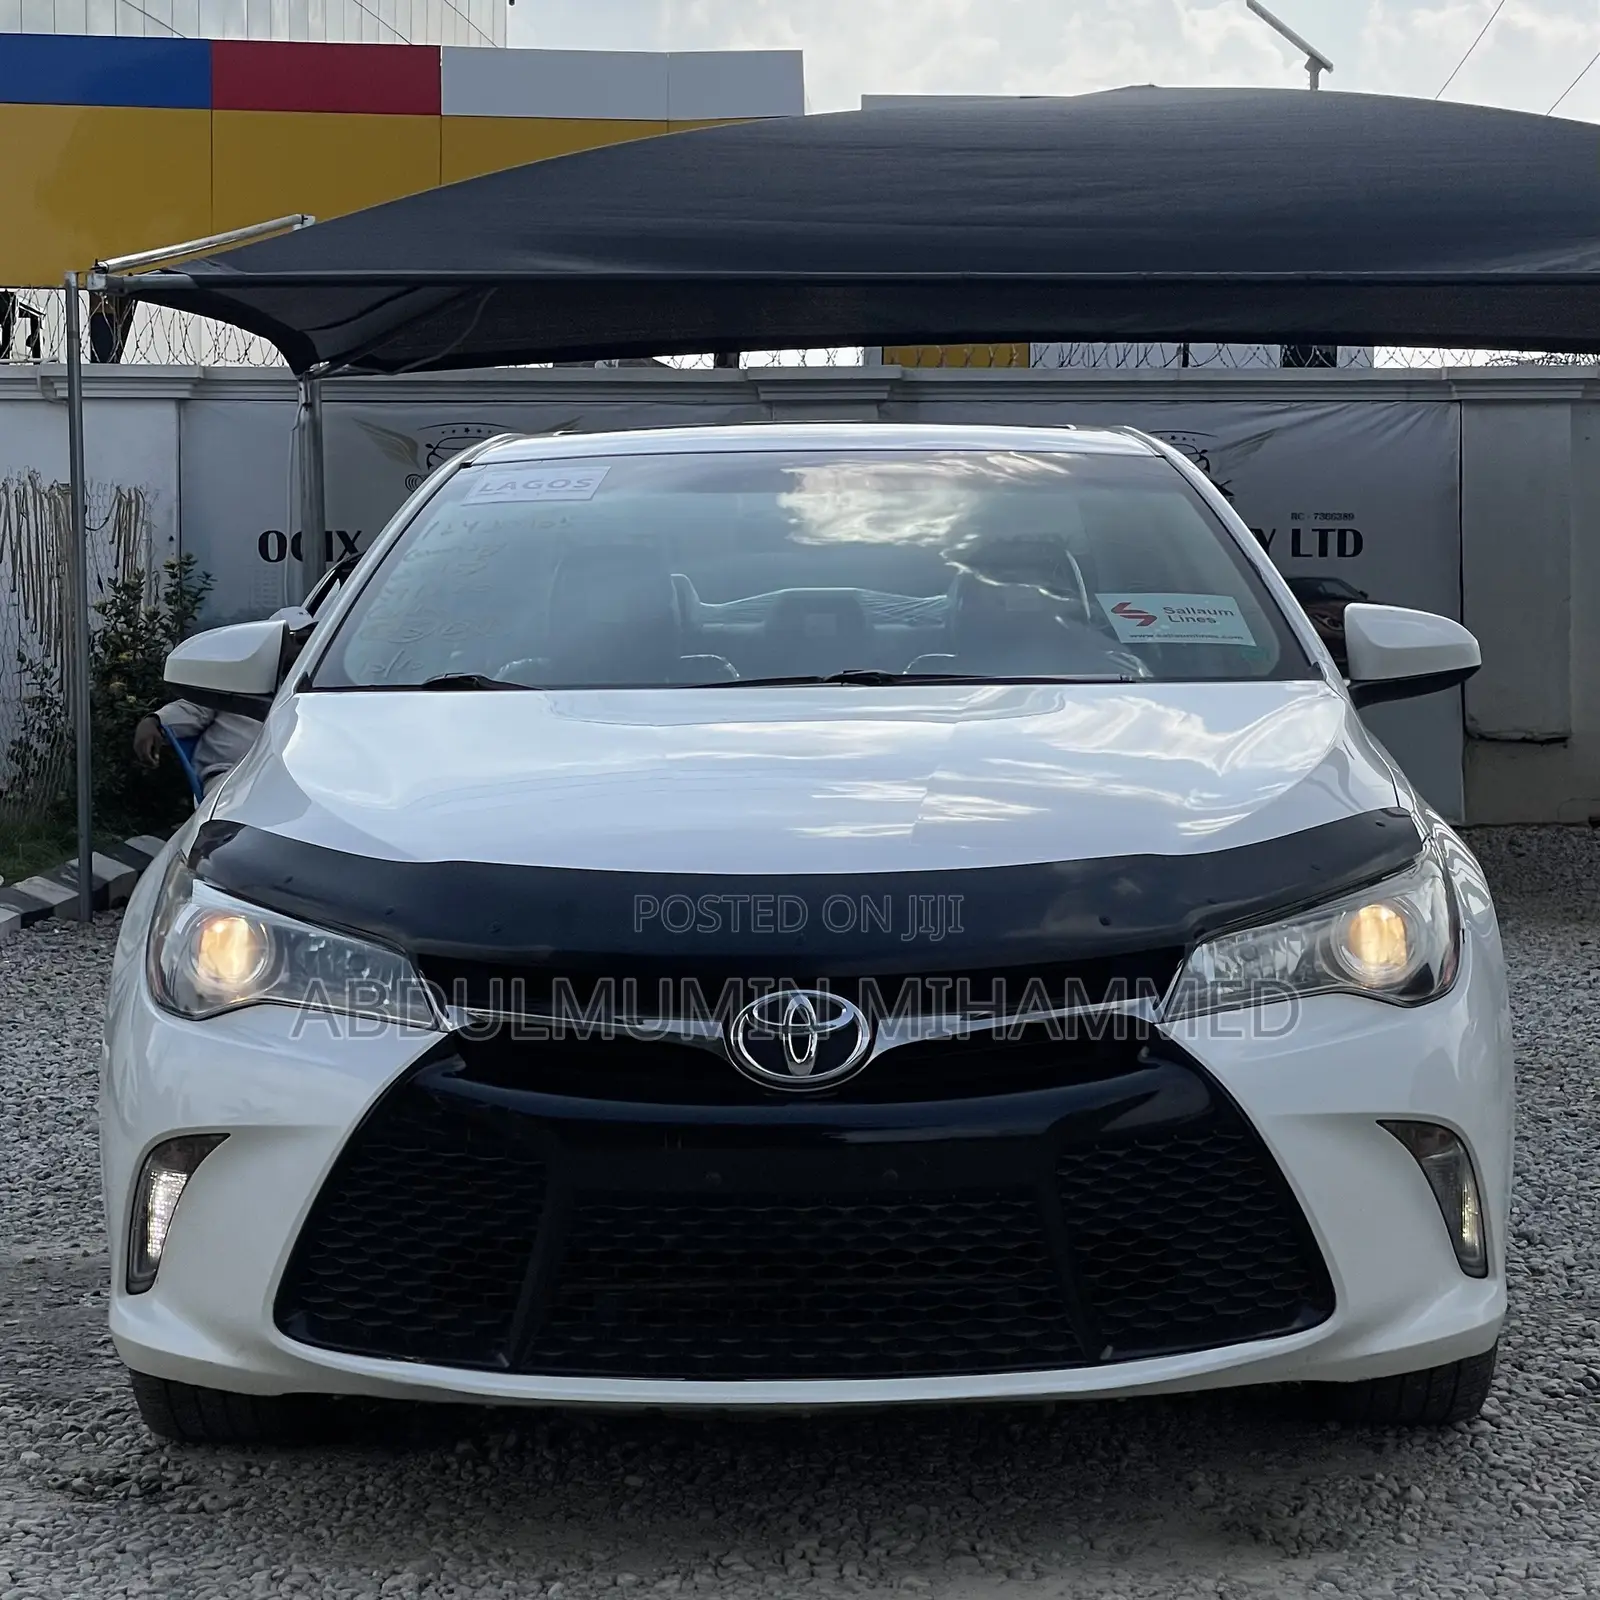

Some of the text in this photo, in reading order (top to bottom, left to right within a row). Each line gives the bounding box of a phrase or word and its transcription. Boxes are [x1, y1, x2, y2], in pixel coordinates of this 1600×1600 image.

[478, 478, 595, 493] LAGOS
[1291, 512, 1304, 520] RC
[1291, 528, 1364, 558] LTD
[1163, 606, 1234, 617] Sallaum
[1168, 614, 1217, 624] Lines
